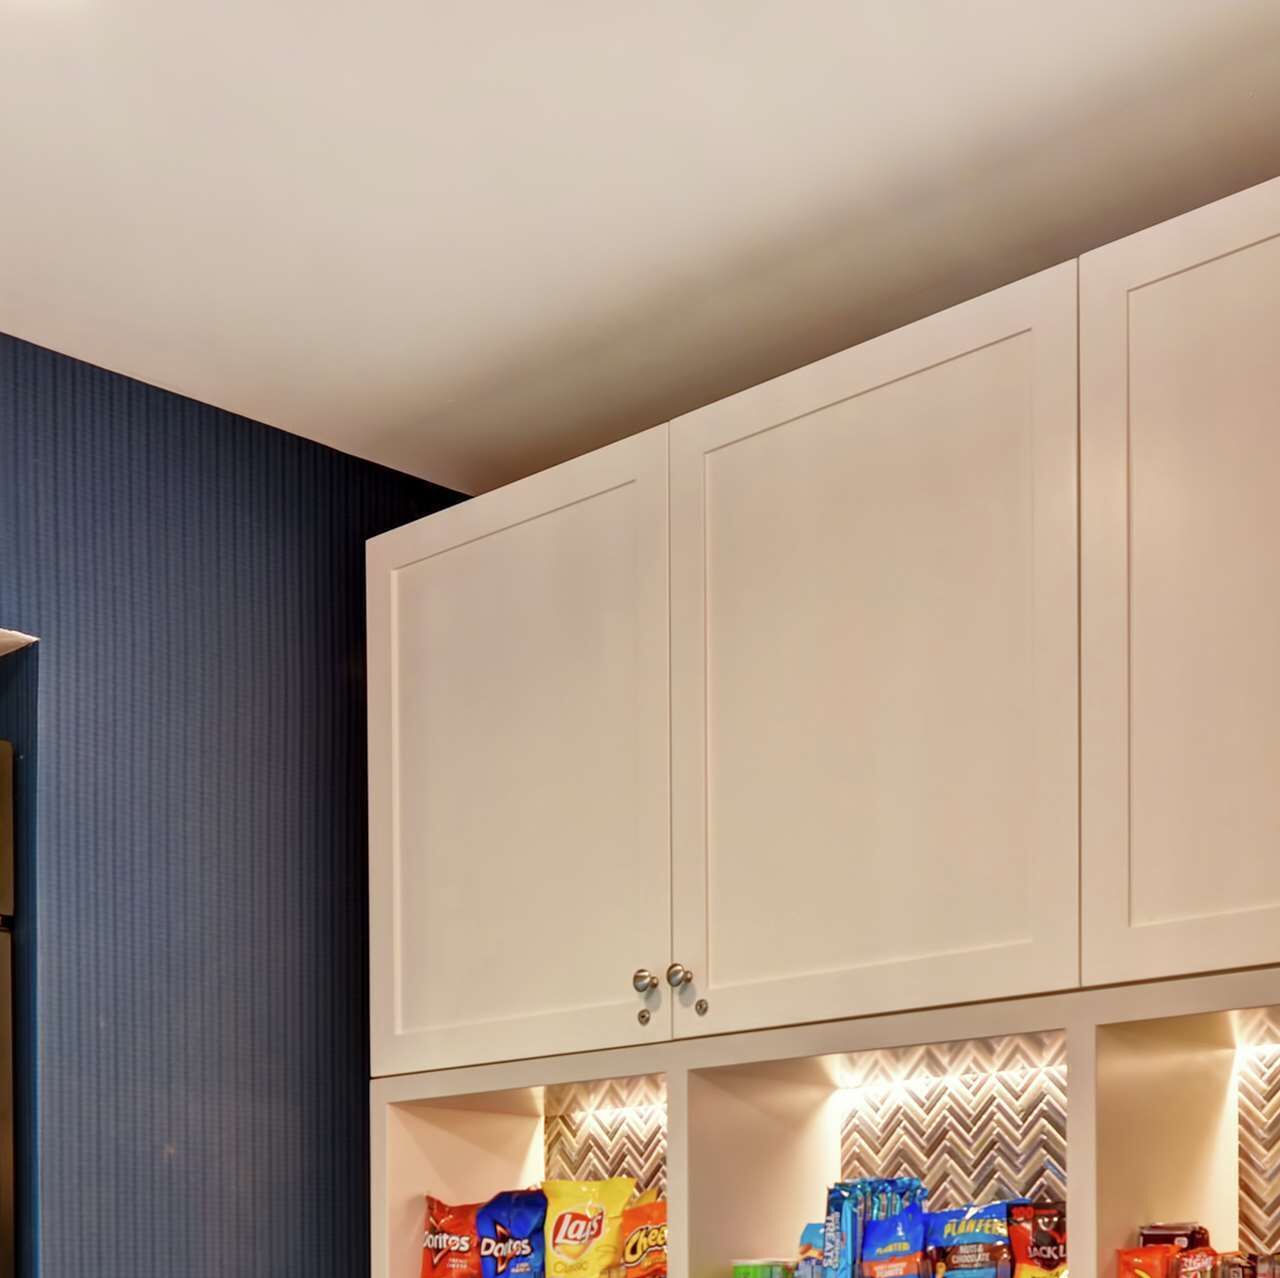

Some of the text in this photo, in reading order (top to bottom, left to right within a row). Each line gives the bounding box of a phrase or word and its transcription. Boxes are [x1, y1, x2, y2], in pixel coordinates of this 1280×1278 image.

[554, 1210, 604, 1245] Lay's
[822, 1215, 834, 1268] TREATS
[480, 1236, 532, 1258] Doritos
[623, 1225, 667, 1262] Chee
[1028, 1244, 1056, 1261] JACK
[951, 1252, 991, 1264] CHOCOLATE
